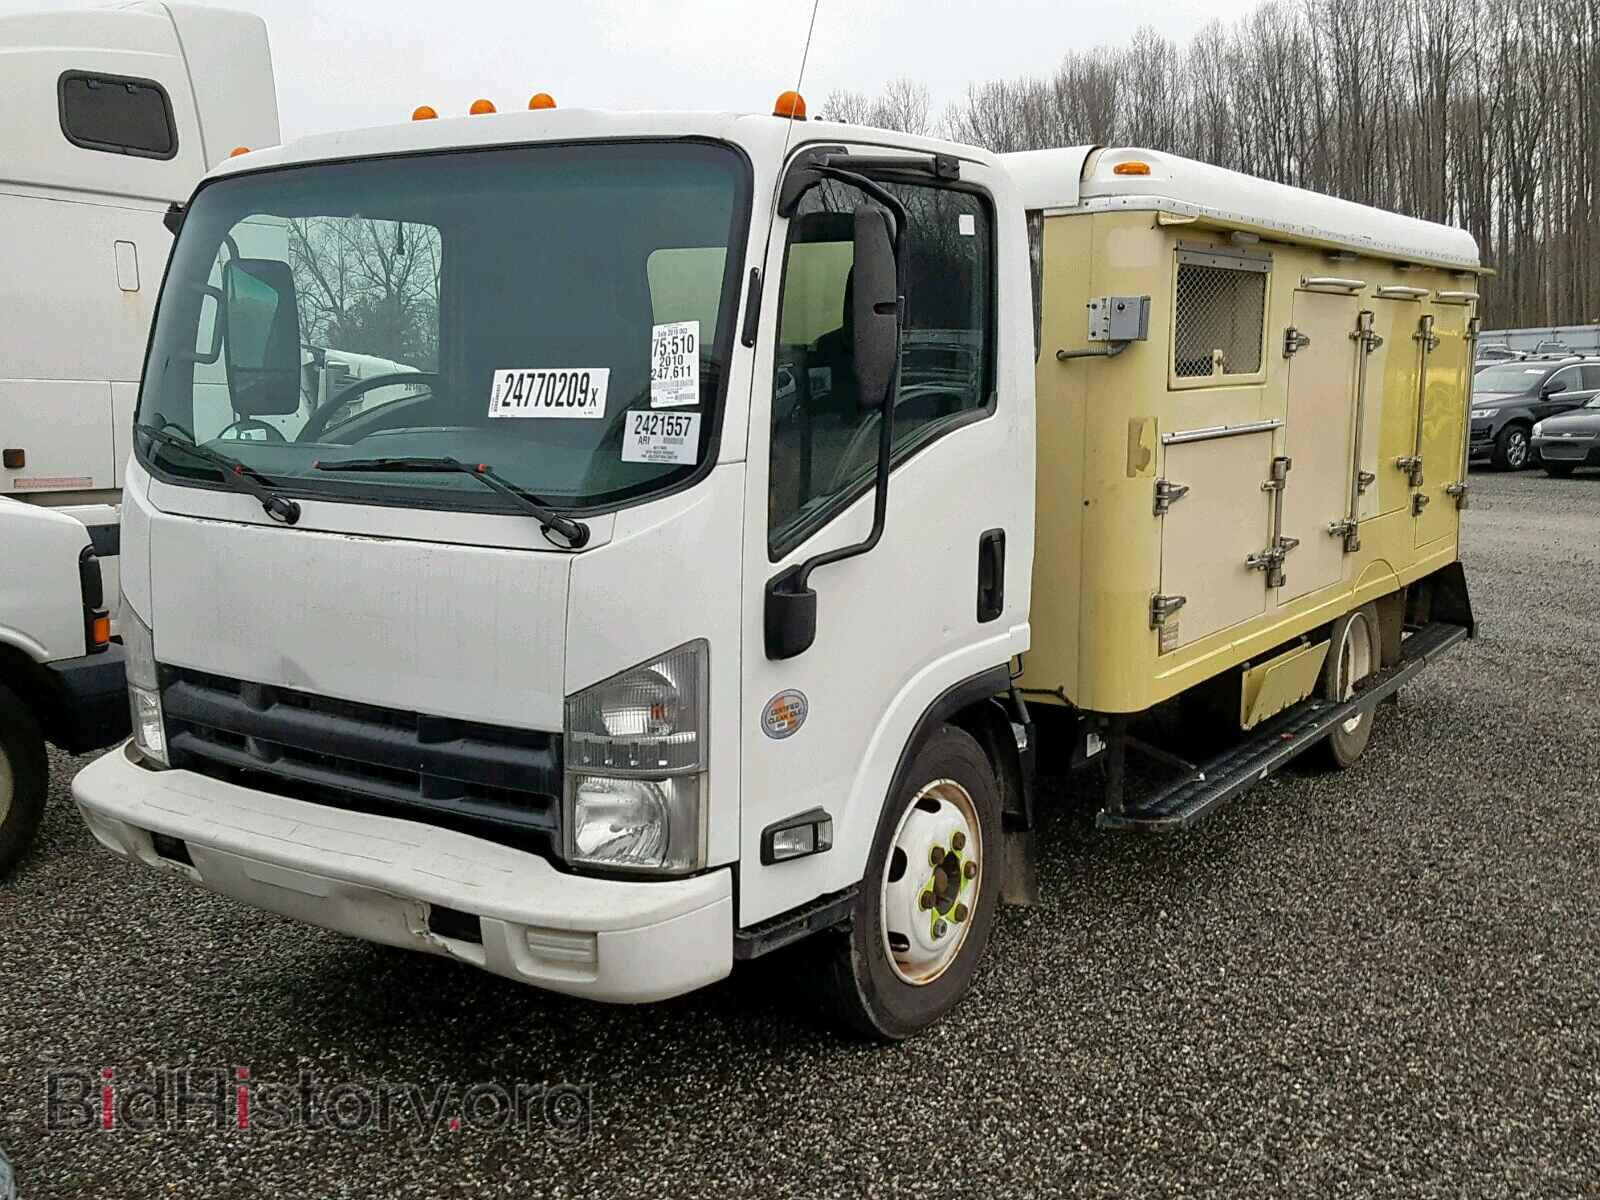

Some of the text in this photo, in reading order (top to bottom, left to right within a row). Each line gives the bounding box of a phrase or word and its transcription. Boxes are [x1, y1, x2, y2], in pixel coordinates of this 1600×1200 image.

[659, 355, 684, 368] 2010
[651, 366, 691, 381] 247,611
[634, 414, 692, 437] 2421557
